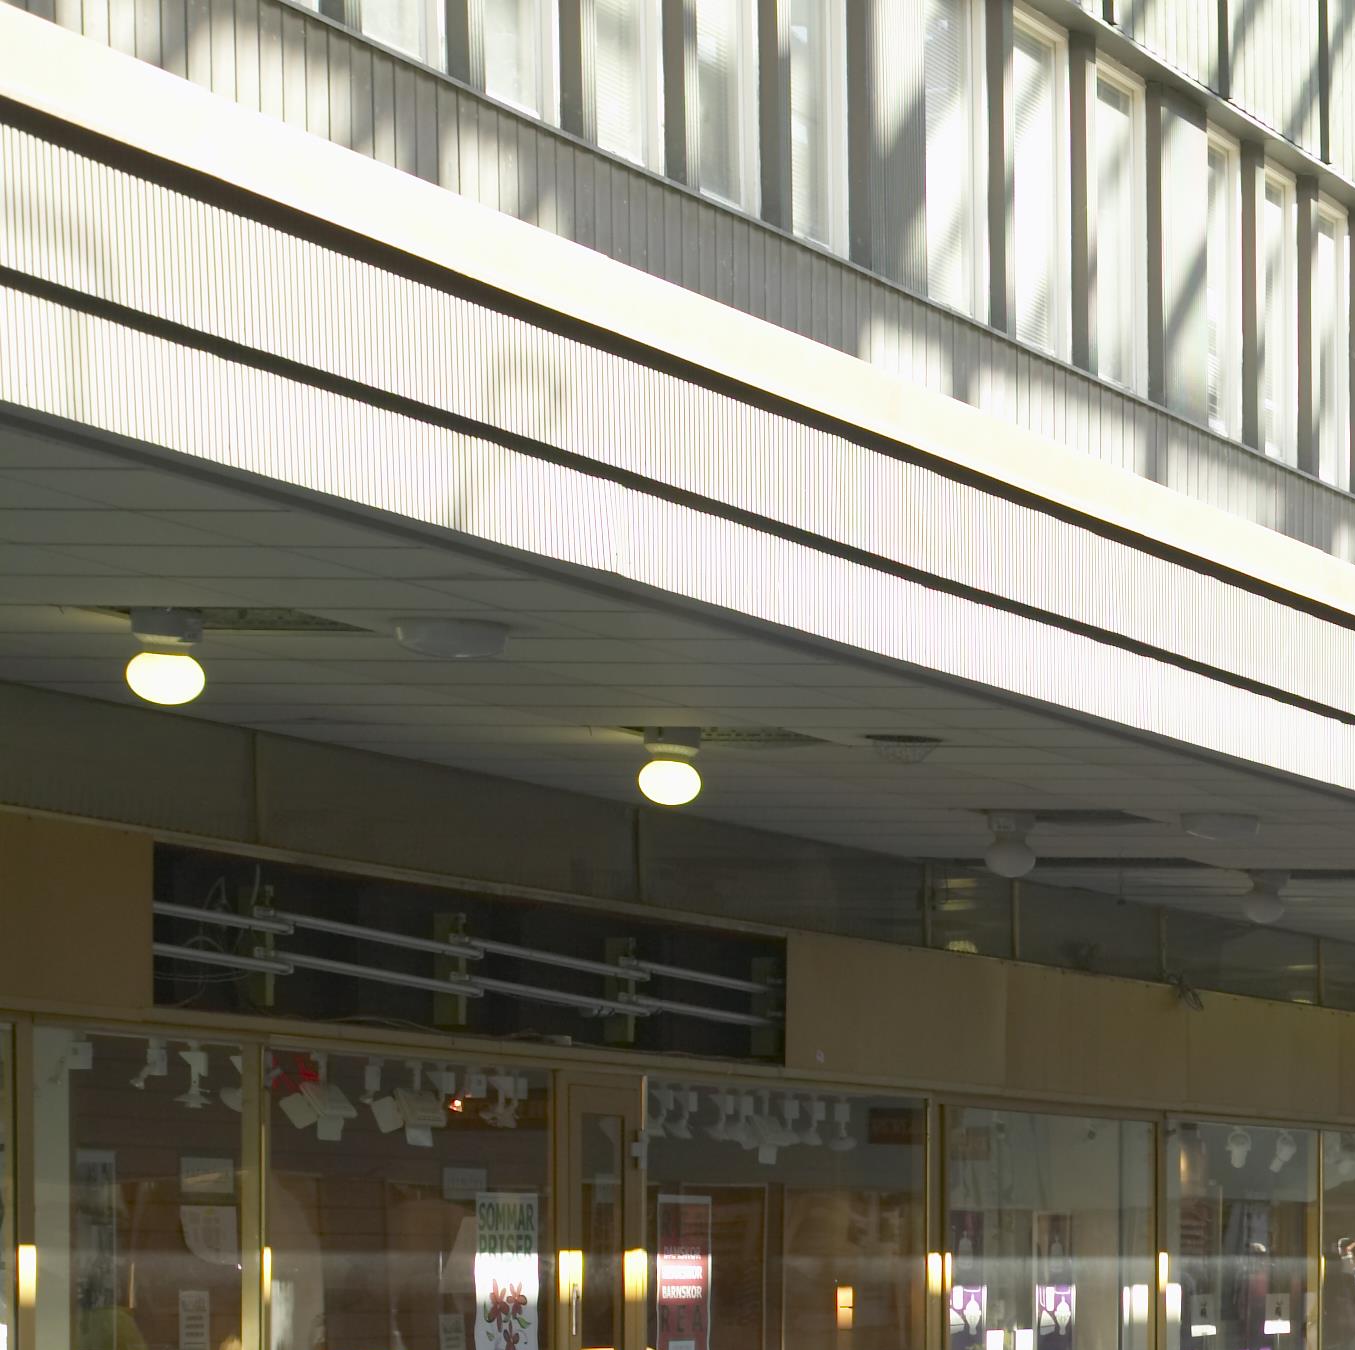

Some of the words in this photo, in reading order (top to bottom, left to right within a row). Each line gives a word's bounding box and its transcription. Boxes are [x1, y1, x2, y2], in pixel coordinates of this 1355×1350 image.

[478, 1202, 534, 1232] SOMMAR
[478, 1233, 533, 1256] PRISER
[662, 1285, 703, 1300] BARNSKOR
